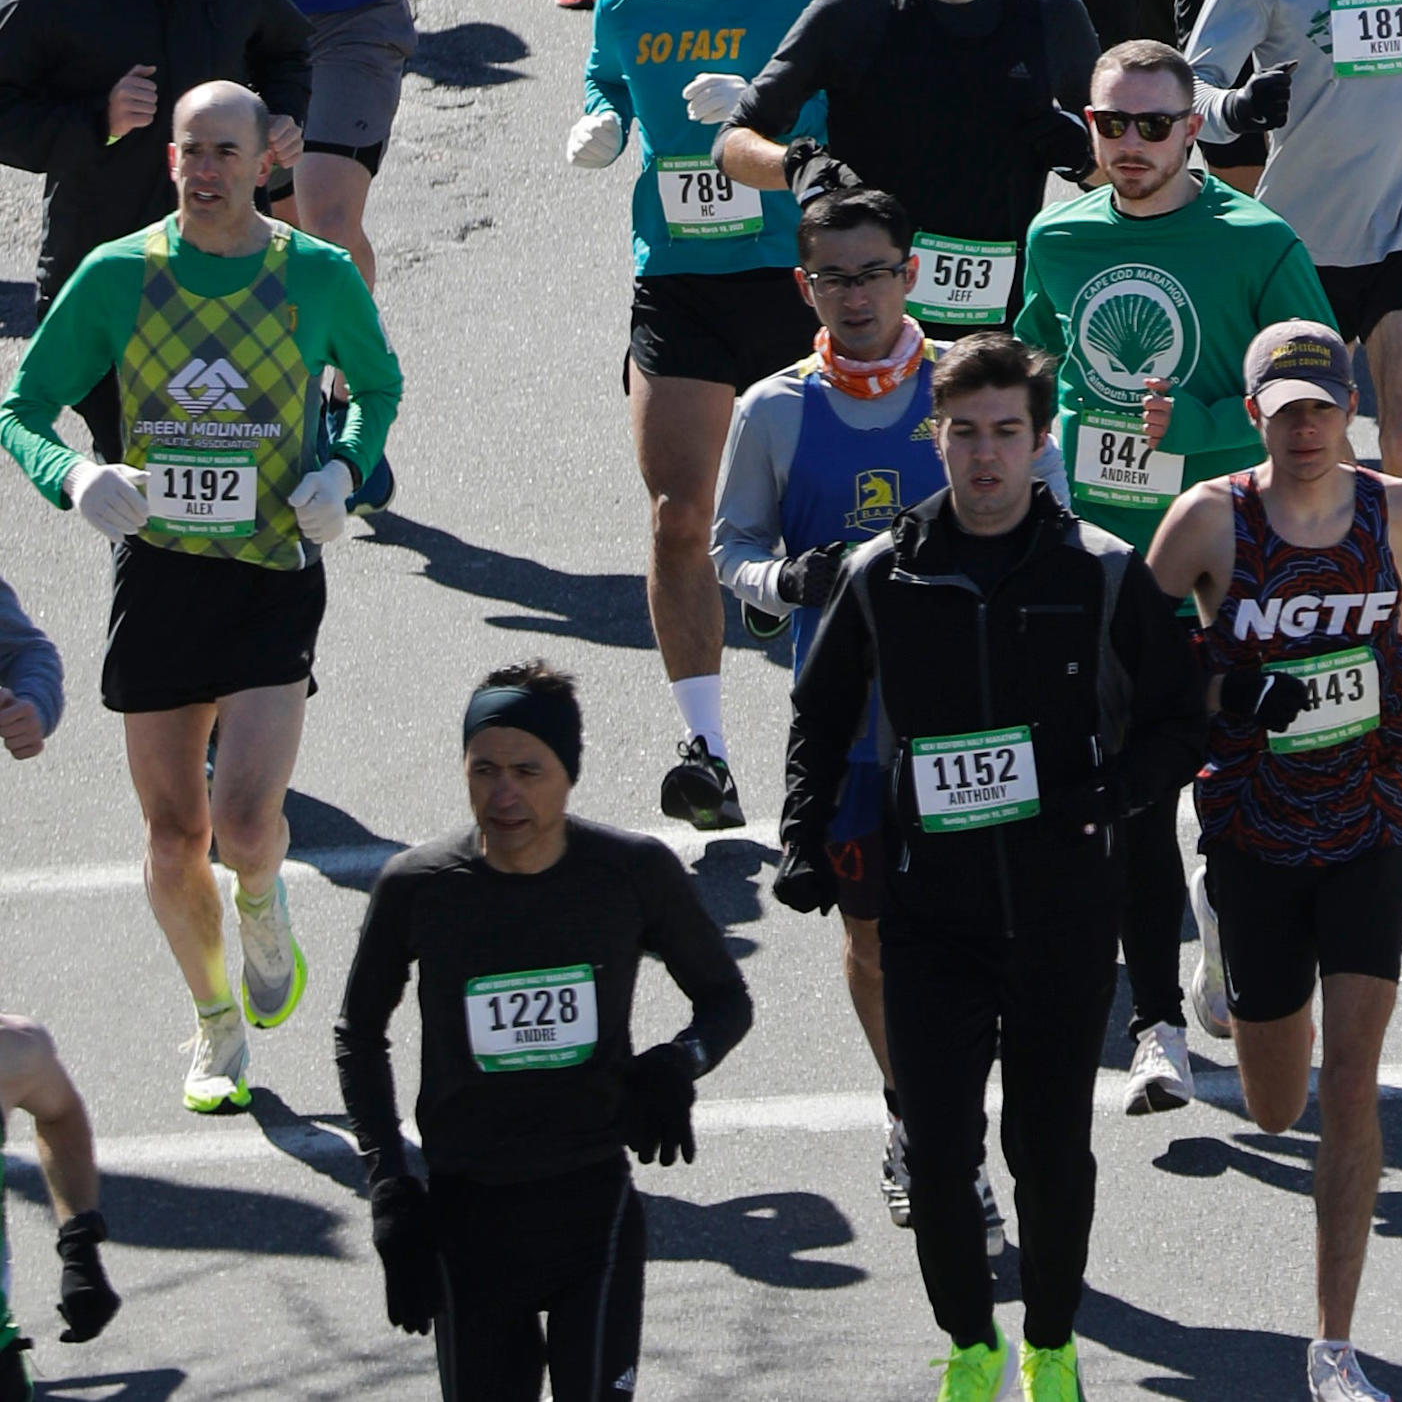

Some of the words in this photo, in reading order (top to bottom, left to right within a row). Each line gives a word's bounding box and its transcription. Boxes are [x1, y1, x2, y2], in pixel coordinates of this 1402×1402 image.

[636, 33, 673, 65] SO
[677, 27, 747, 63] FAST
[1367, 39, 1399, 54] KEVIN
[678, 171, 735, 204] 789
[700, 203, 716, 217] HC
[933, 255, 994, 290] 563
[1083, 277, 1111, 302] CAPE
[1110, 269, 1134, 284] COD
[1136, 268, 1187, 309] MARATHON
[947, 288, 974, 303] JEFF
[1085, 369, 1128, 402] Falmouth
[192, 421, 282, 437] MOUNTAIN
[194, 437, 262, 449] ASSOCIATION
[1098, 432, 1149, 465] 847
[161, 468, 241, 502] 1192
[1099, 466, 1149, 485] ANDREW
[185, 501, 214, 516] ALEX
[1232, 590, 1400, 643] NGTF
[1300, 669, 1365, 712] 443
[932, 745, 1019, 788] 1152
[946, 784, 1008, 806] ANTHONY
[488, 988, 580, 1032] 1228
[515, 1026, 557, 1044] ANDRE
